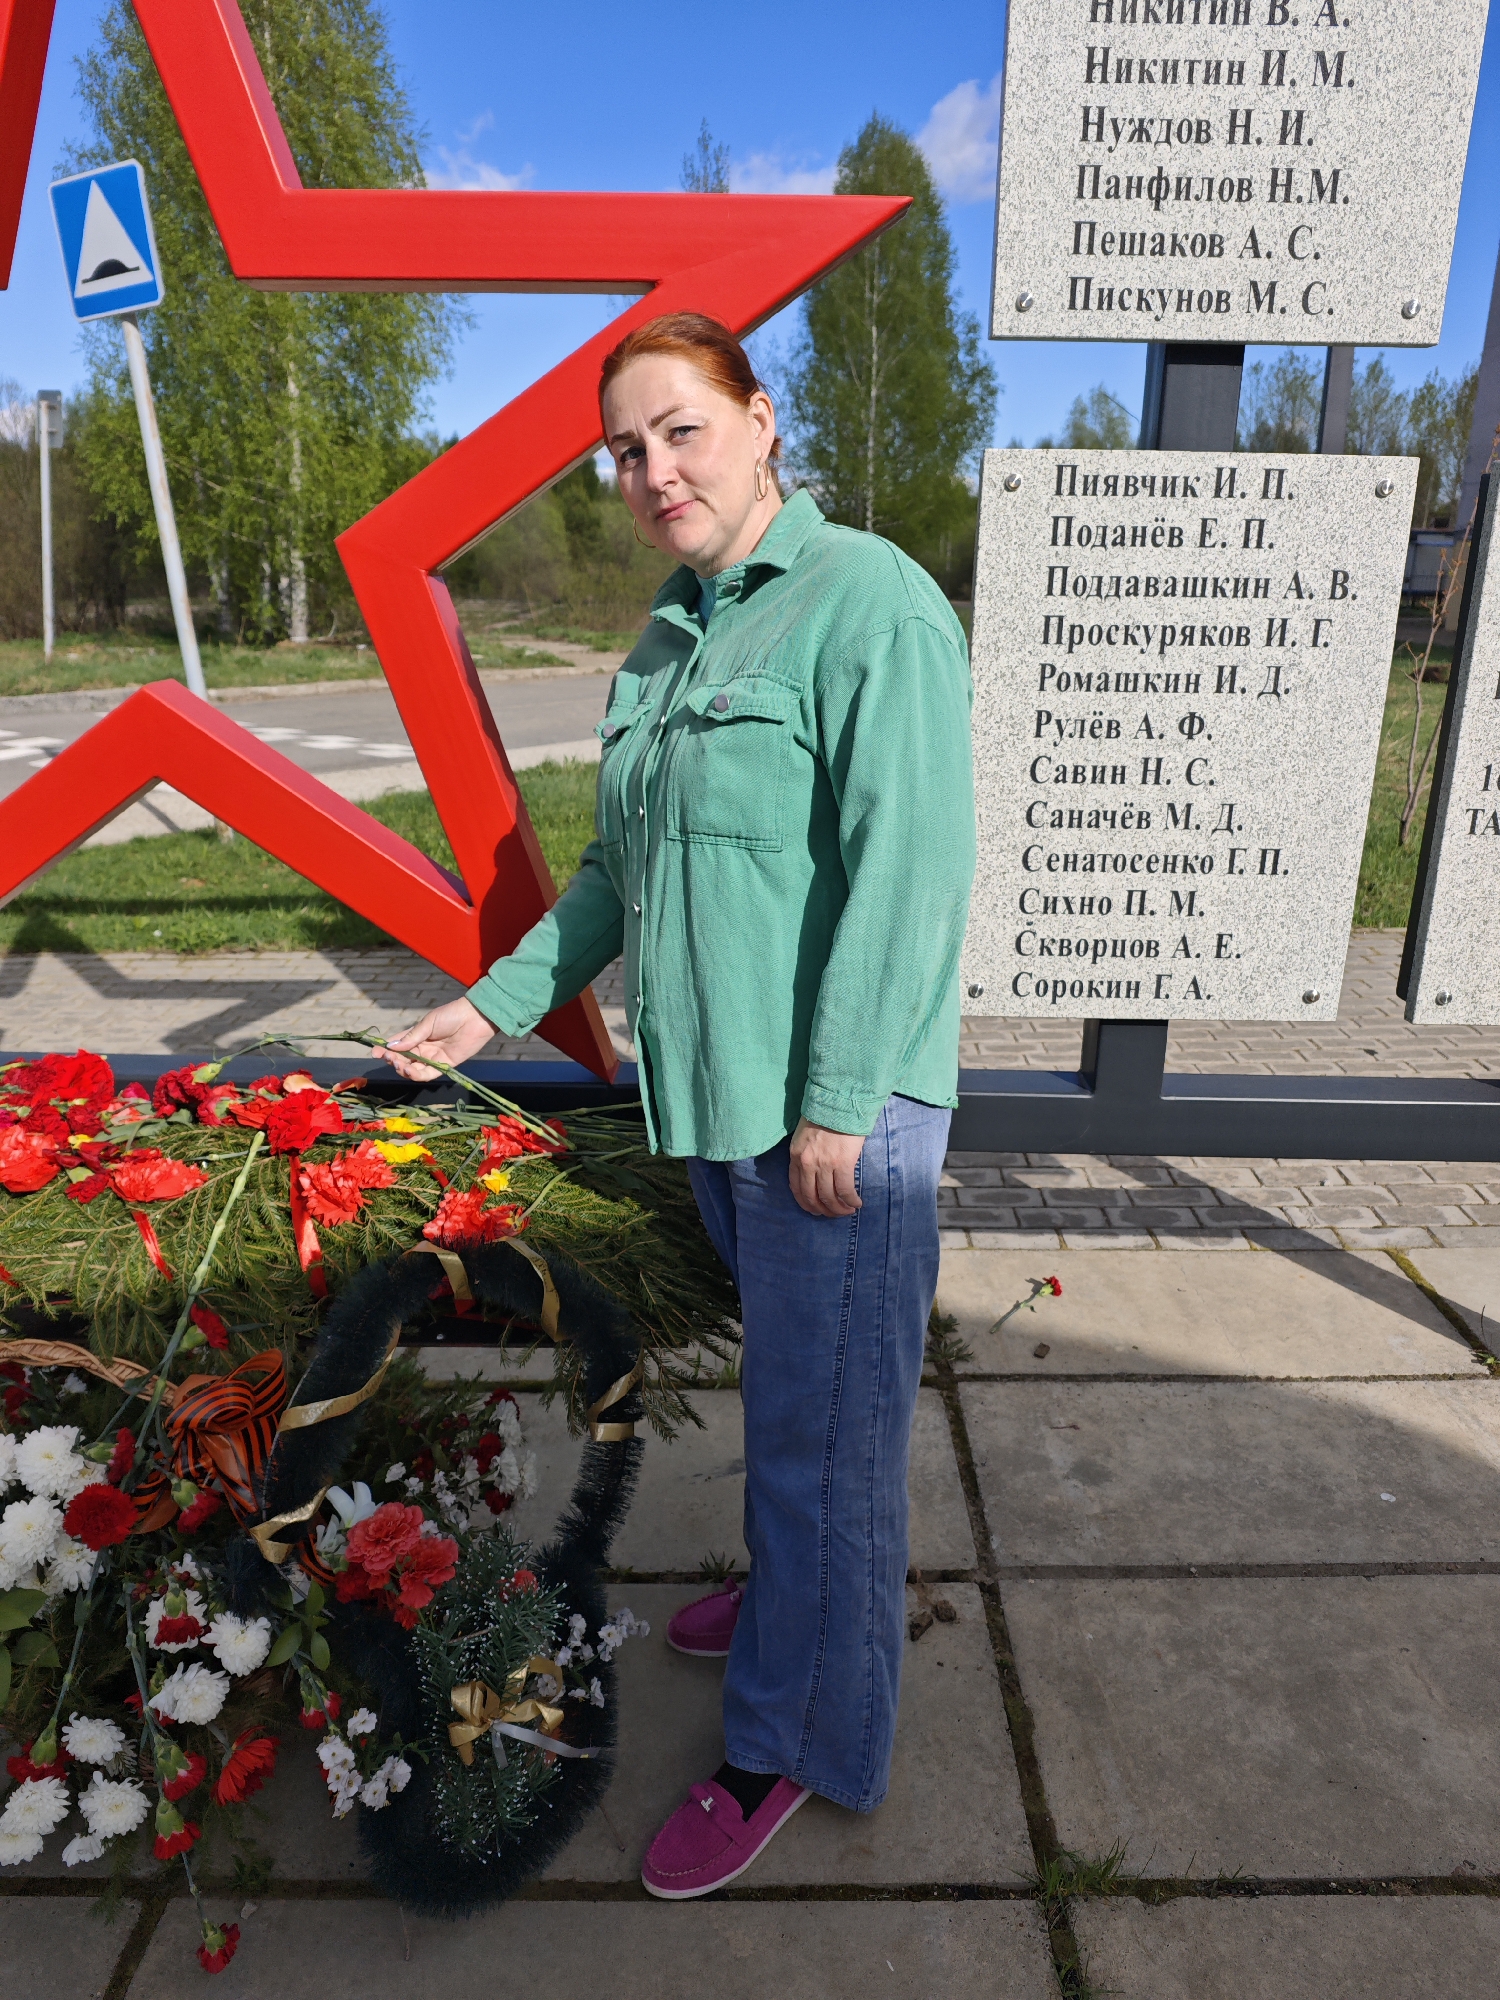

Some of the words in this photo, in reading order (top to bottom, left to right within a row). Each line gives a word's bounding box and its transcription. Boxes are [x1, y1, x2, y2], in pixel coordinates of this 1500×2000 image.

[1084, 46, 1246, 85] Никитин
[1259, 50, 1296, 87] И.
[1311, 50, 1354, 88] М.
[1080, 106, 1212, 153] Нуждов
[1225, 108, 1262, 145] Н.
[1277, 109, 1314, 146] И.
[1076, 164, 1253, 210] Панфилов
[1072, 221, 1225, 258] Пешаков
[1237, 224, 1272, 259] А.
[1287, 224, 1320, 261] С.
[1068, 276, 1230, 321] Пискунов
[1246, 279, 1286, 315] М.
[1301, 280, 1334, 316] С.
[1053, 464, 1200, 498] Пиявчик
[1213, 466, 1246, 498] И.
[1261, 468, 1294, 500] П.
[1049, 515, 1184, 550] Поданёв
[1198, 517, 1227, 549] Е.
[1241, 518, 1274, 549] П.
[1045, 565, 1270, 599] Поддавашкин
[1283, 569, 1314, 600] А.
[1327, 569, 1357, 601] В.
[1041, 614, 1251, 654] Проскуряков
[1262, 617, 1297, 648] И.
[1309, 618, 1333, 648] Г.
[1038, 663, 1201, 694] Ромашкин
[1213, 665, 1246, 694] И.
[1257, 666, 1290, 700] Д.
[1033, 709, 1121, 747] Рулёв
[1135, 711, 1164, 741] А.
[1178, 711, 1212, 741] Ф.
[1029, 755, 1126, 785] Савин
[1139, 757, 1171, 786] Н.
[1186, 757, 1215, 787] С.
[1025, 800, 1151, 830] Саначёв
[1164, 803, 1201, 830] М.
[1210, 803, 1243, 836] Д.
[1021, 845, 1214, 875] Сенатосенко
[1226, 848, 1246, 875] Г.
[1258, 848, 1289, 876] П.
[1018, 887, 1112, 915] Сихно
[1123, 889, 1155, 917] П.
[1168, 890, 1204, 917] М.
[1015, 929, 1160, 965] Скворцов
[1171, 934, 1201, 959] А.
[1213, 934, 1241, 959] Е.
[1012, 971, 1140, 1004] Сорокин
[1153, 974, 1172, 999] Г.
[1182, 976, 1211, 1001] А.
